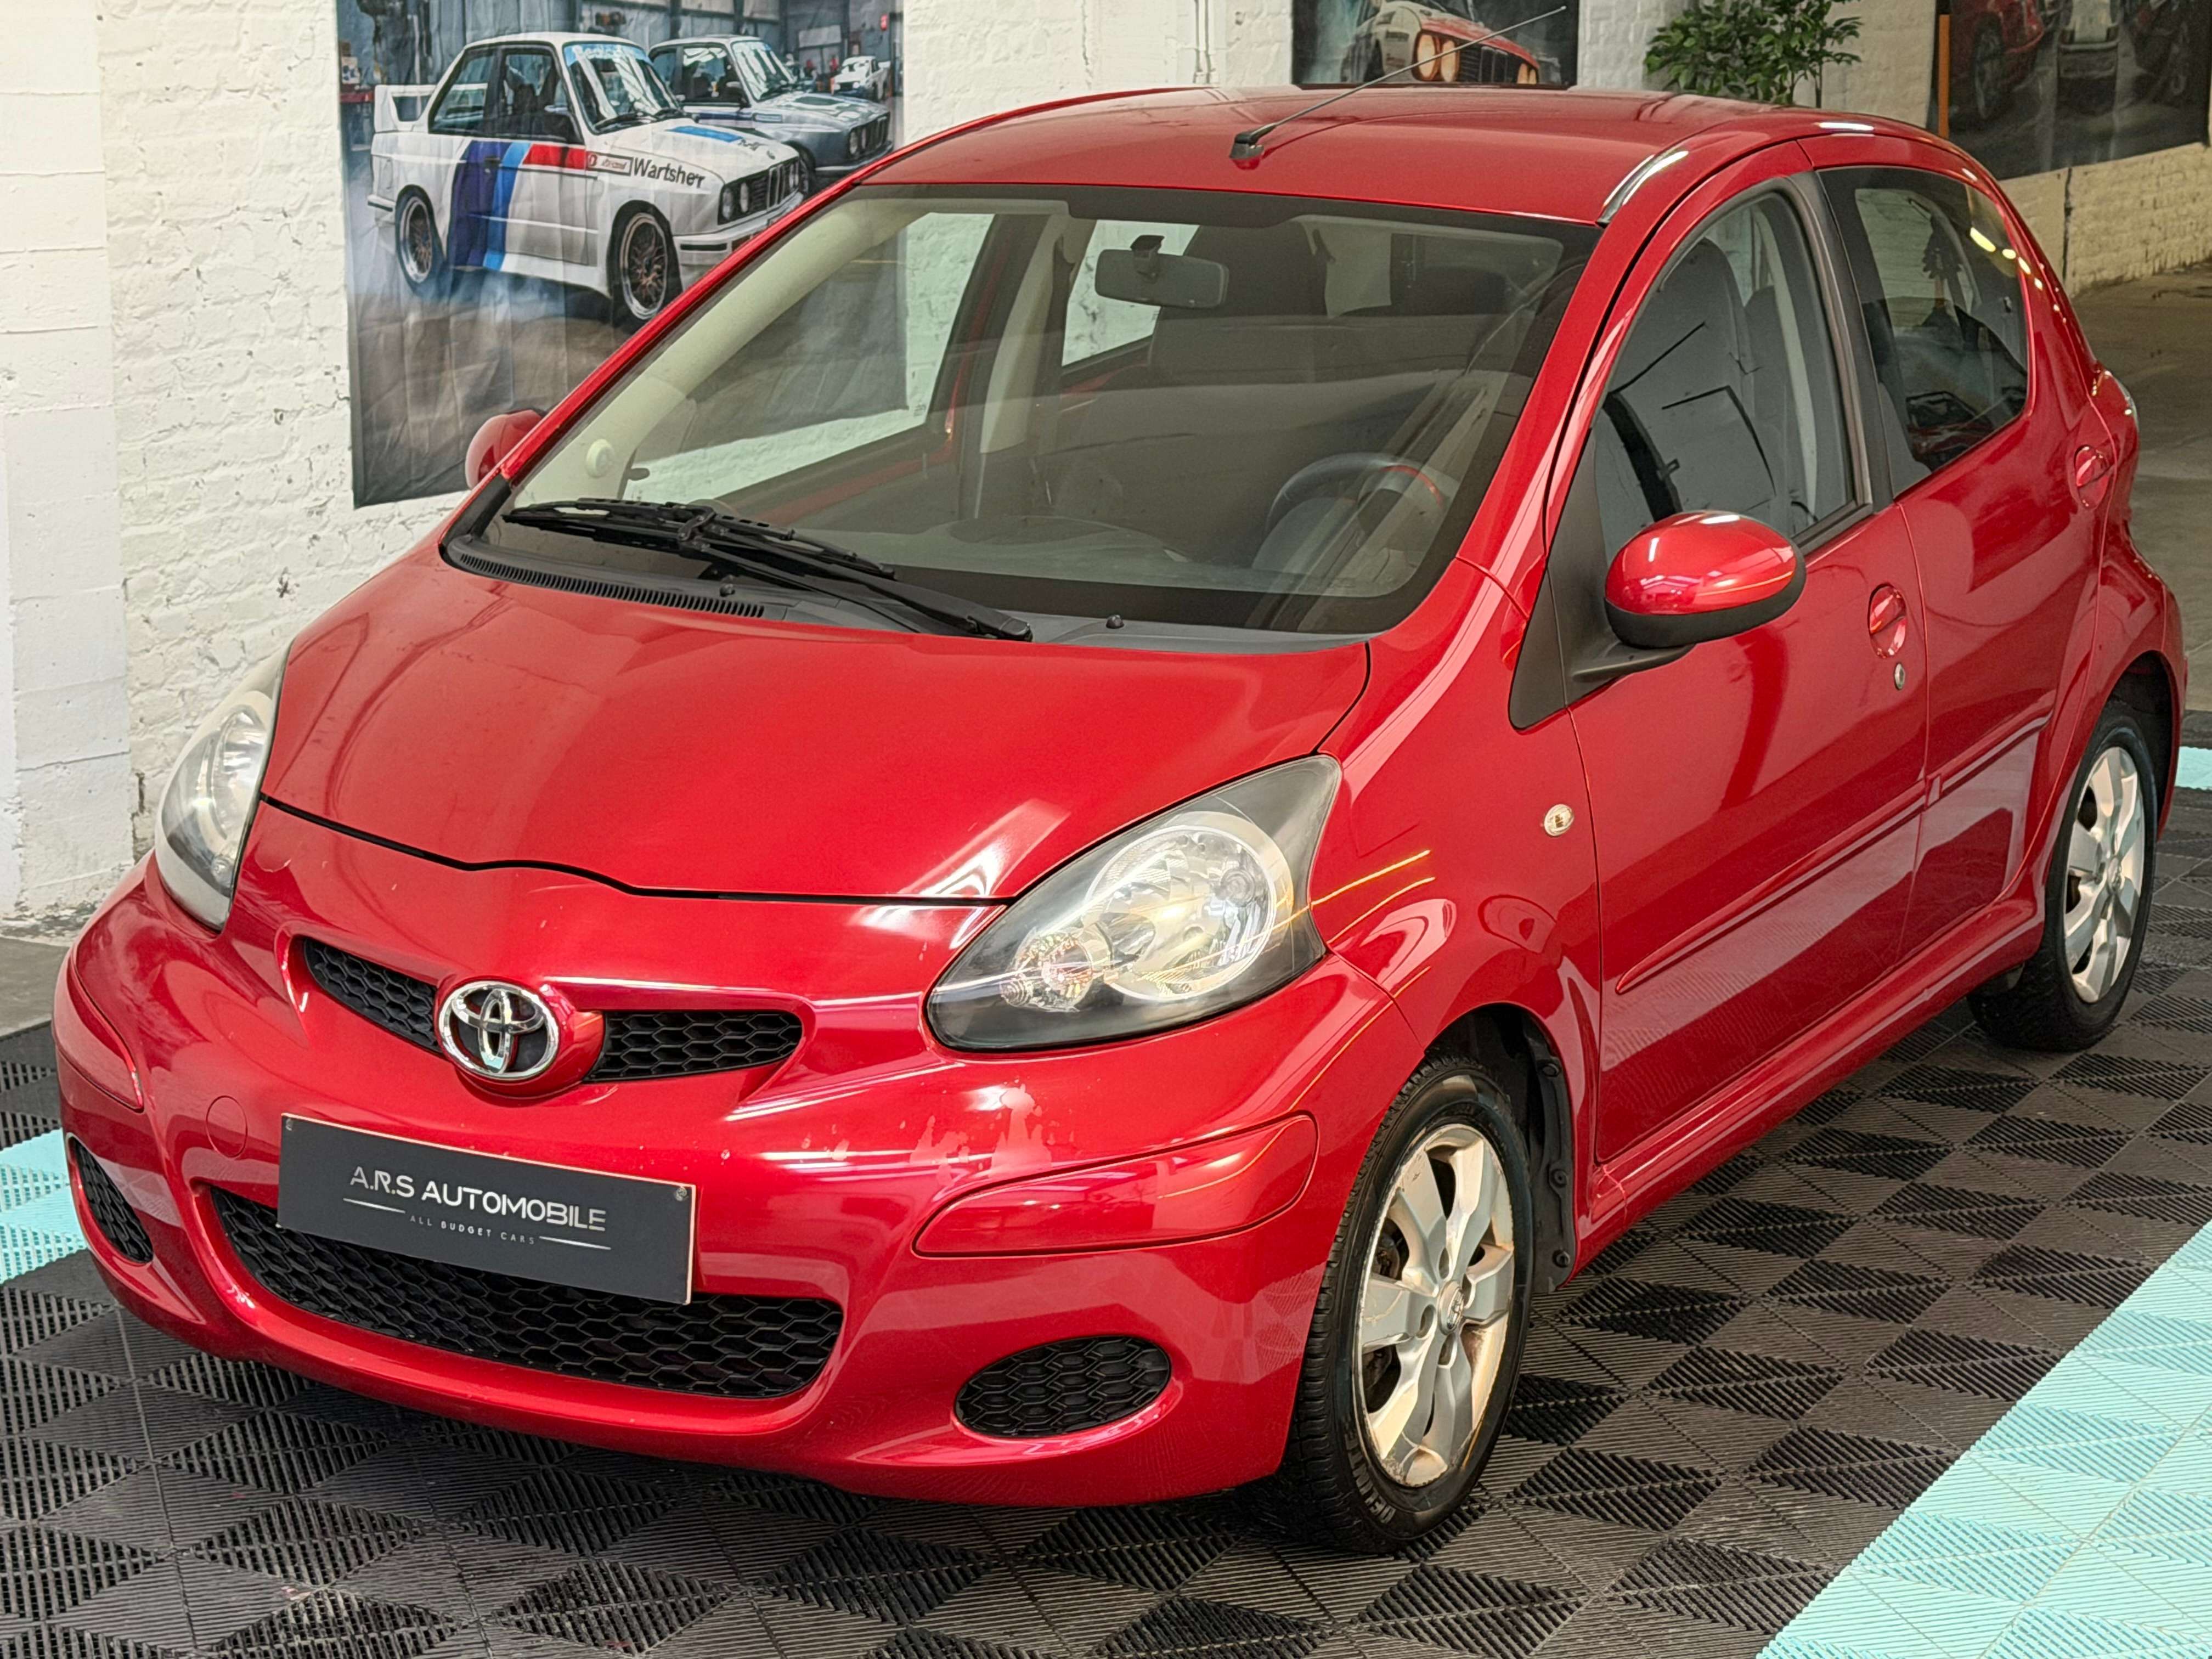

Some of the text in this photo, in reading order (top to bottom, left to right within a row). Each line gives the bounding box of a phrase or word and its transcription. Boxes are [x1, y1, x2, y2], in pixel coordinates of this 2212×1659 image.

[633, 157, 706, 189] Wartsher
[350, 1166, 606, 1231] A.R.S AUTOMOBILE
[410, 1215, 534, 1245] ALL BUDGET CARS
